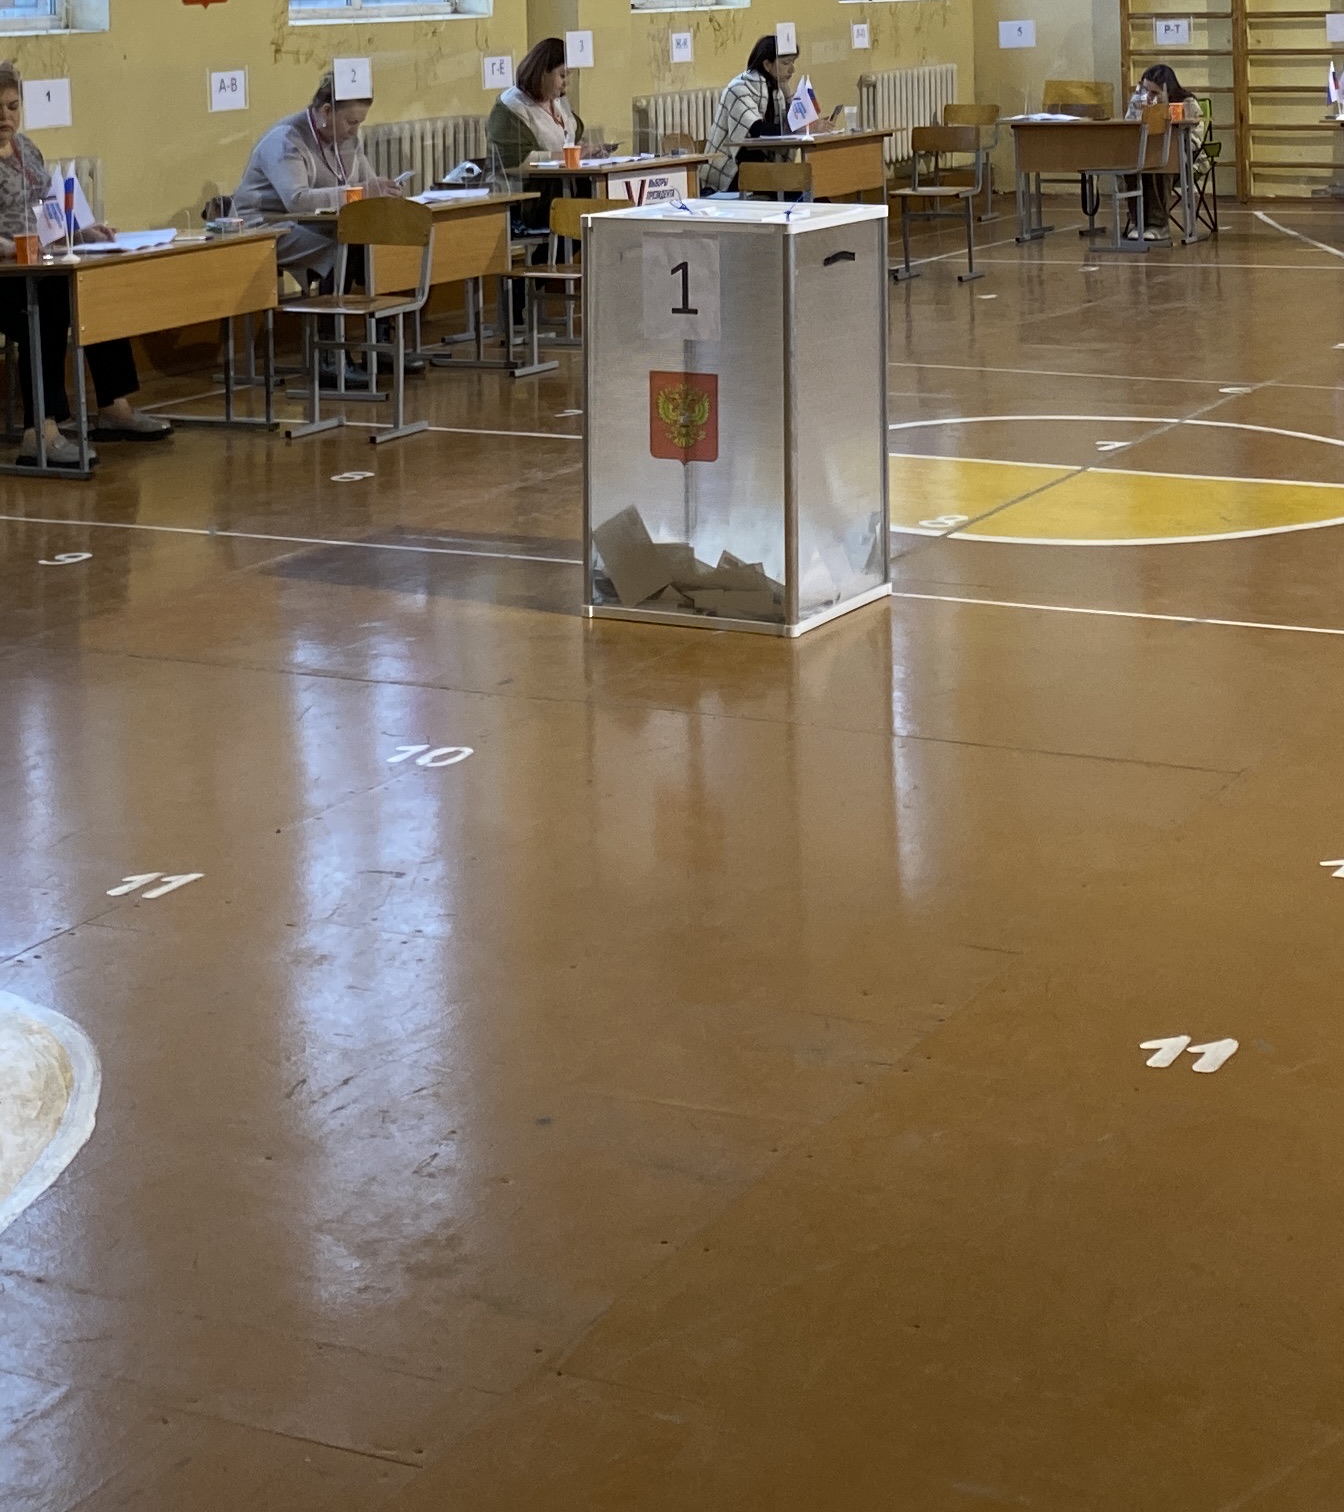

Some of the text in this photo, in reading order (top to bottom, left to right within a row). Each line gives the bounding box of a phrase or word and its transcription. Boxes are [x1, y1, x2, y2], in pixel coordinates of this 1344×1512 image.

[1164, 24, 1181, 34] Р-Т
[350, 68, 357, 83] 2
[45, 90, 51, 102] 1
[671, 261, 698, 315] 1
[330, 471, 375, 482] 8
[919, 514, 969, 528] 8
[38, 552, 93, 565] 9
[386, 744, 474, 767] 10
[105, 872, 205, 899] 11
[1139, 1034, 1239, 1073] 11
